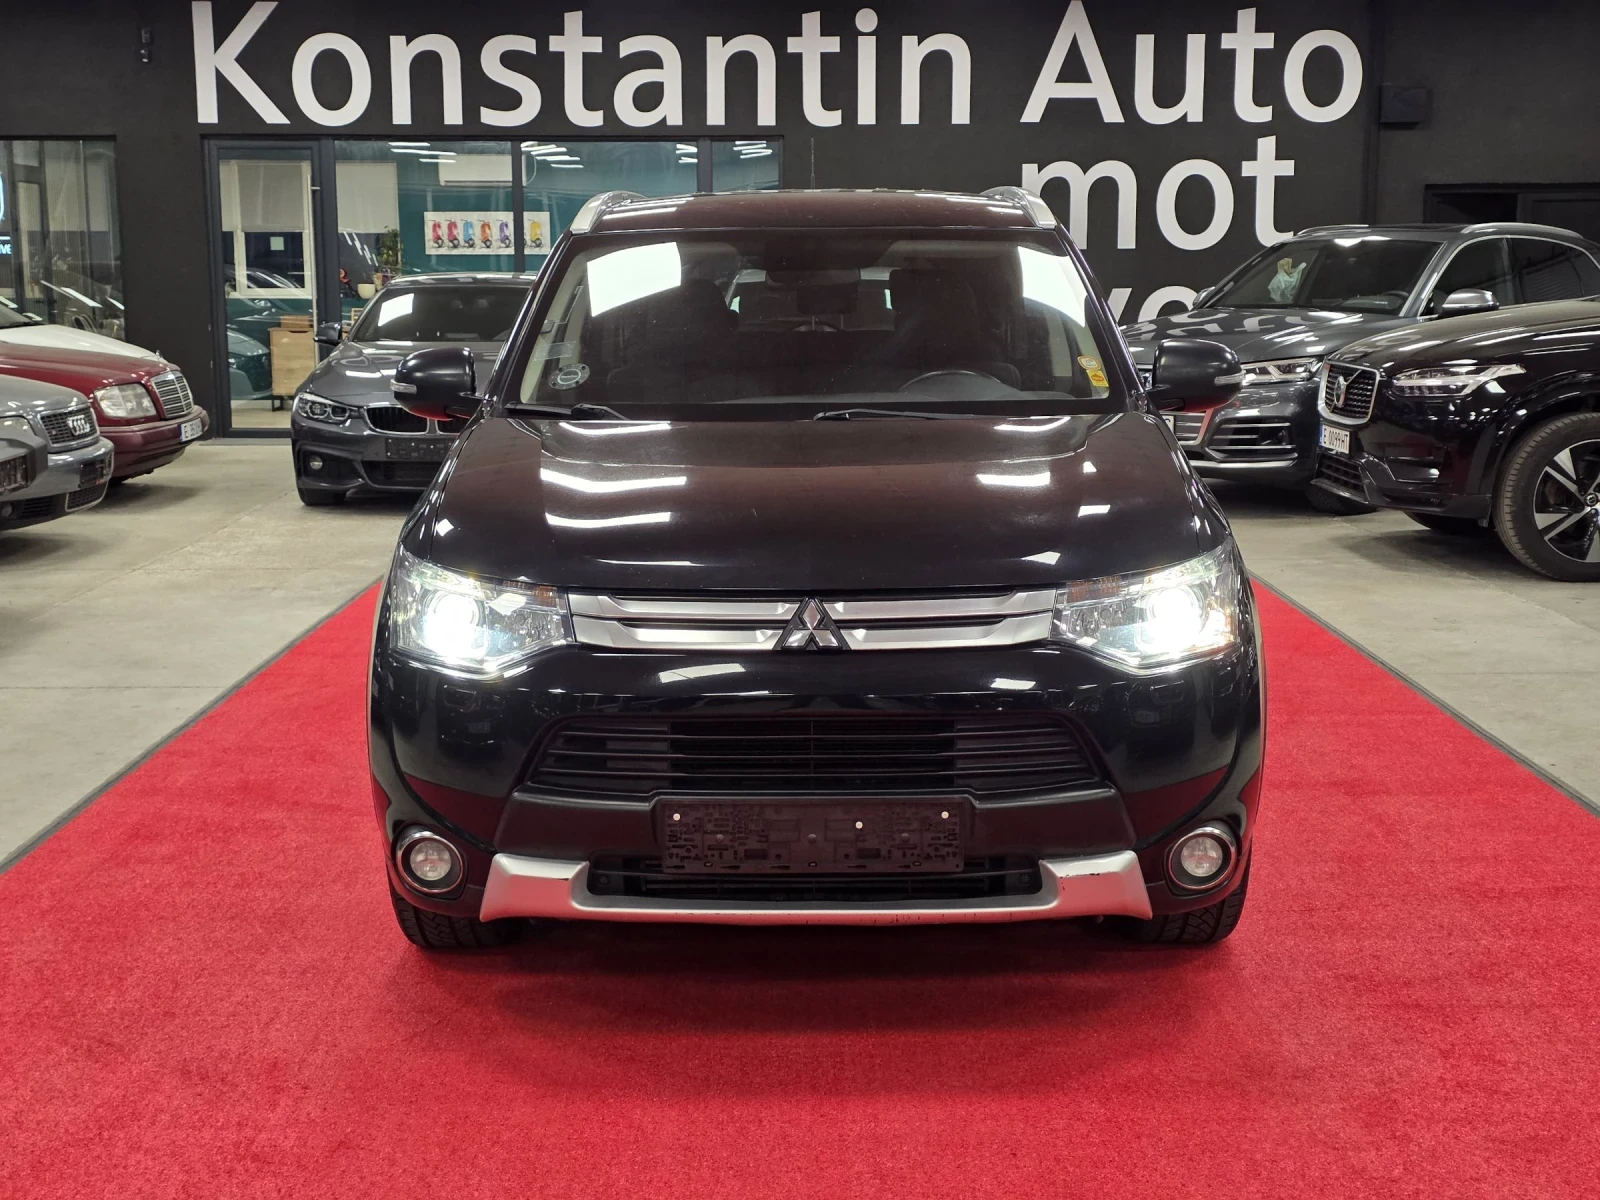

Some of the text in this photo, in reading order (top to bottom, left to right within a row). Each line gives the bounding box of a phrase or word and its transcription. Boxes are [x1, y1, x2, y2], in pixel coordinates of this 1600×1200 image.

[191, 0, 1363, 127] Konstantin Auto
[1021, 135, 1295, 251] mot
